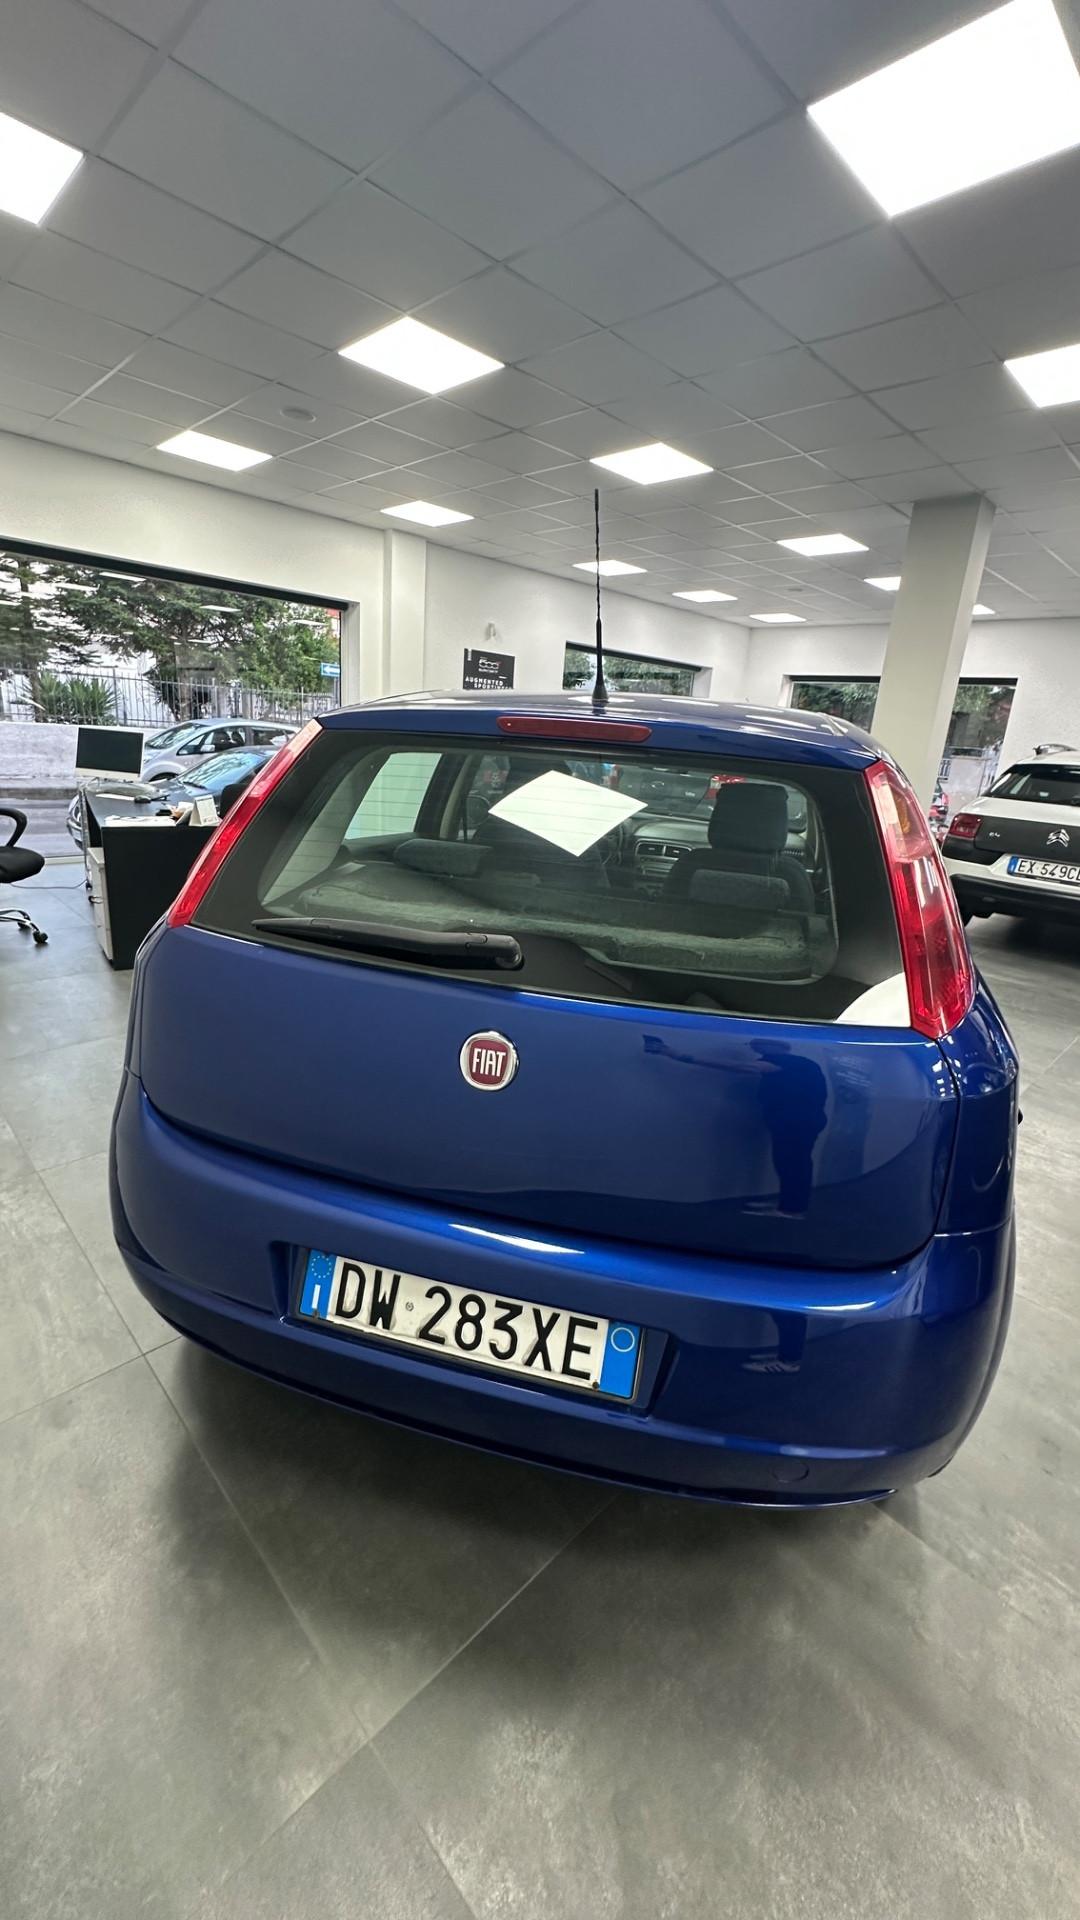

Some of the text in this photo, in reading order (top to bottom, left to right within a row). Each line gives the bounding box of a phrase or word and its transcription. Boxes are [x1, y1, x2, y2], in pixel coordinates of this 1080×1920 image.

[465, 676, 504, 686] AUGMENTED
[1018, 860, 1037, 873] EX
[472, 1047, 507, 1077] FIAT
[335, 1261, 599, 1380] DW 283XE
